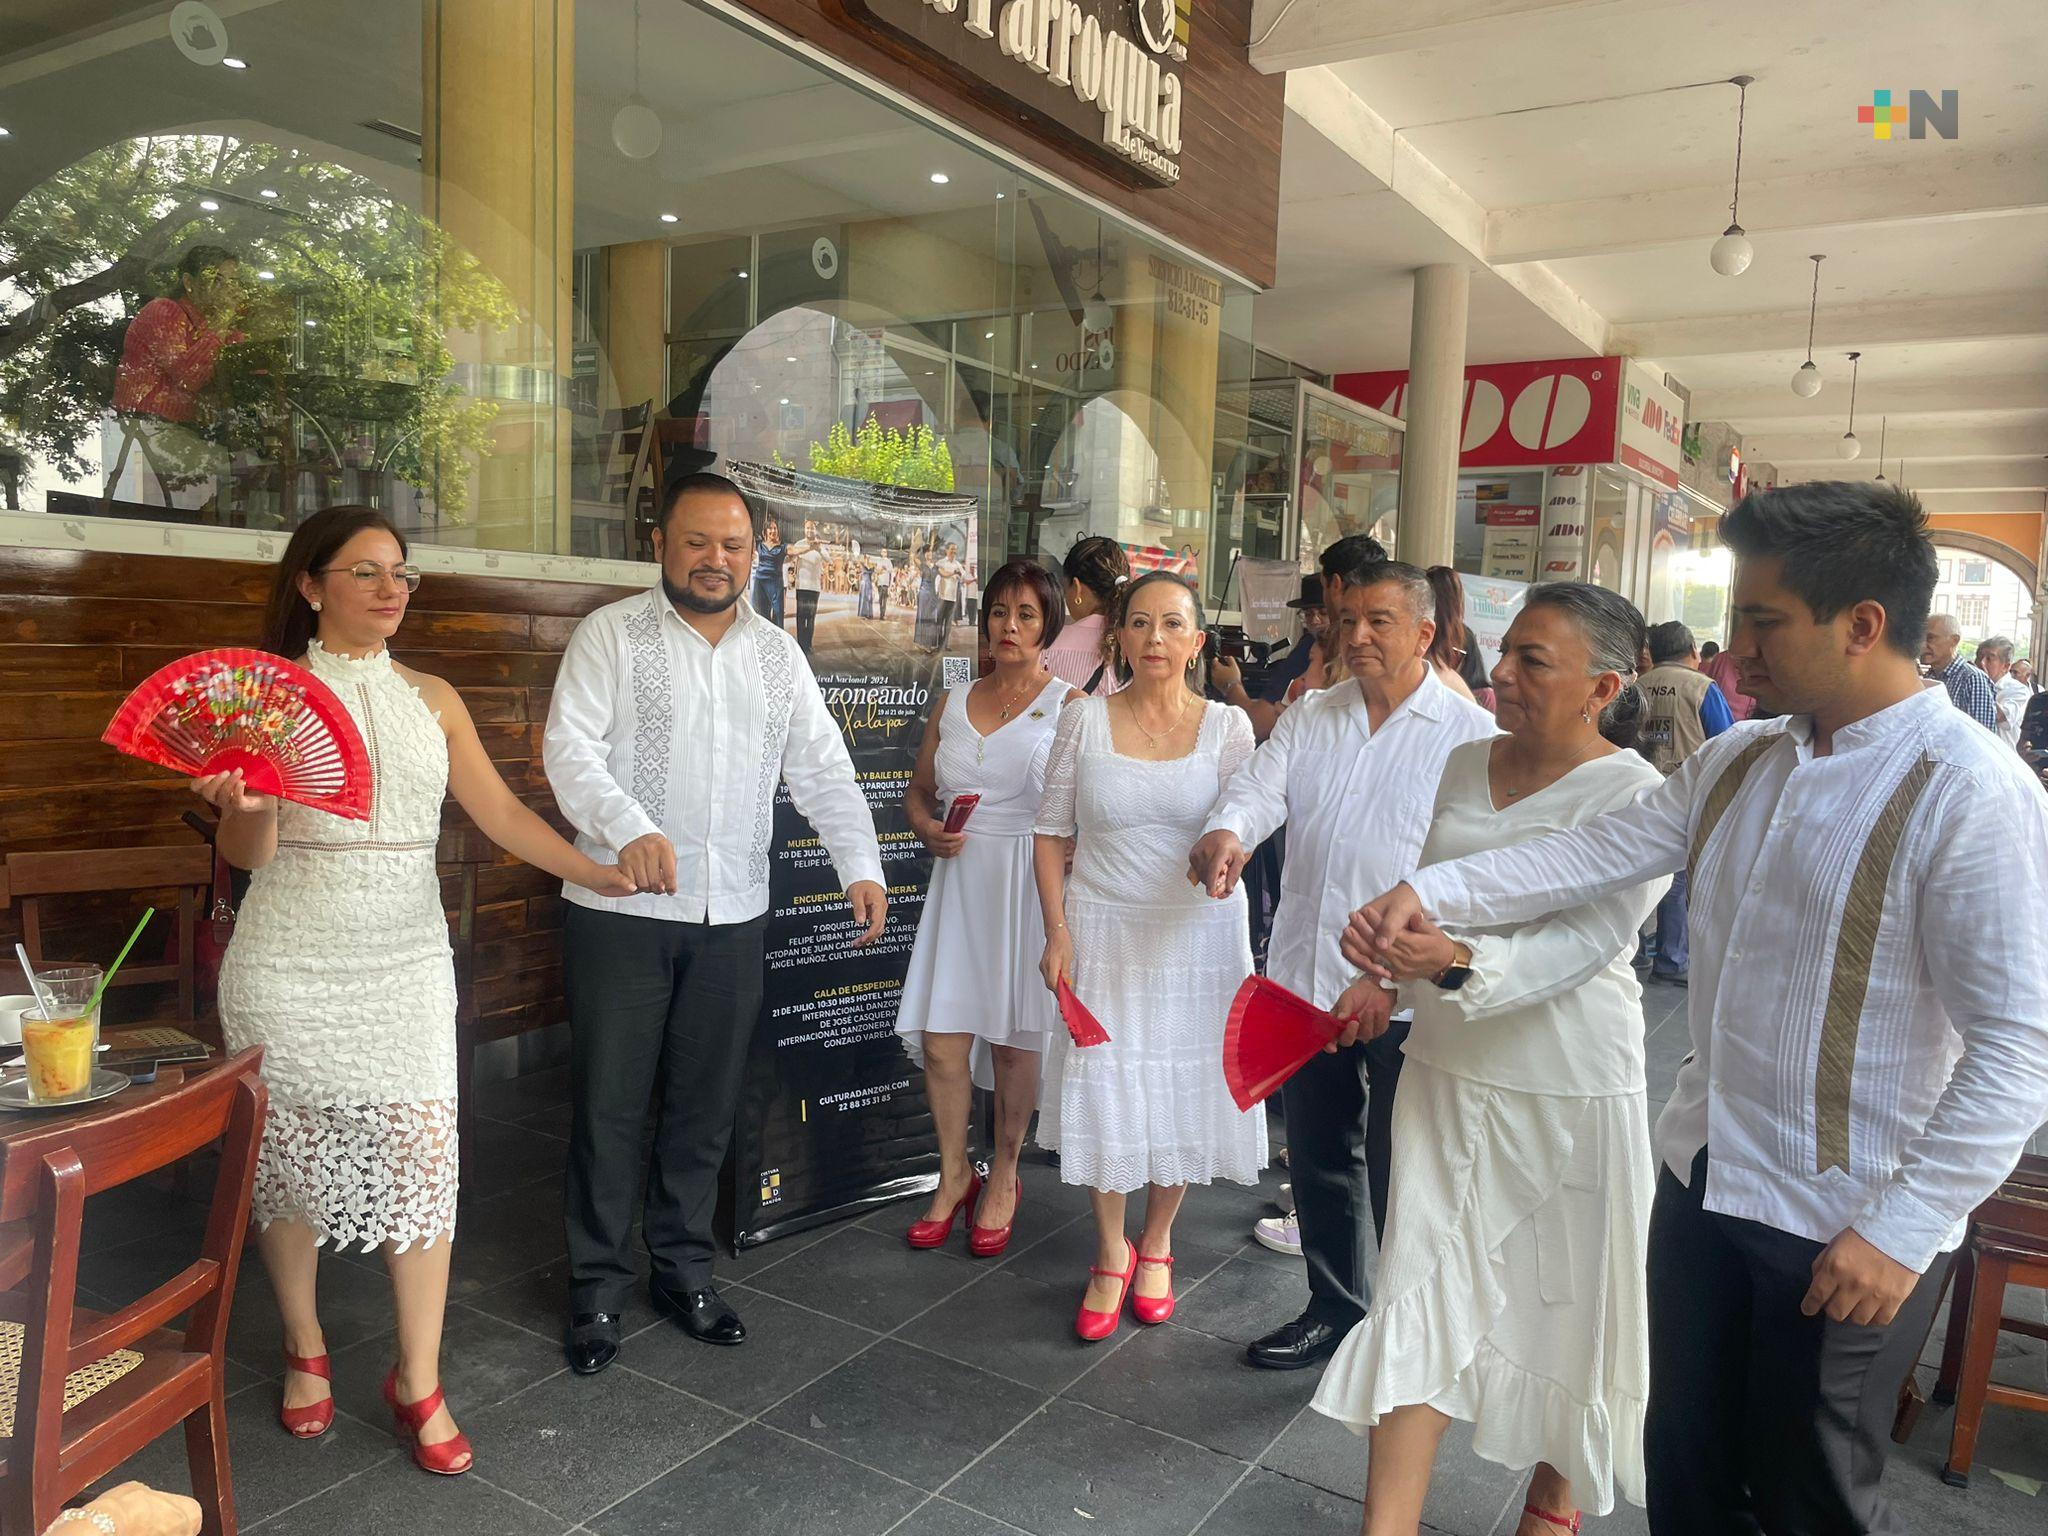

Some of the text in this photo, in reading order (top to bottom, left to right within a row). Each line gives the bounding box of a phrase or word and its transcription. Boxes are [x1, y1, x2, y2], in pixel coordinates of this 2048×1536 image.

[963, 0, 1181, 155] arroquia
[1123, 128, 1180, 181] de Veracruz
[1663, 410, 1680, 446] FedEx
[1548, 496, 1577, 506] ADO
[1548, 523, 1584, 537] ADO
[815, 674, 889, 685] ival Nacional 2024
[832, 690, 908, 747] Xalapa
[905, 708, 916, 718] julio
[1645, 720, 1670, 732] MVS
[862, 772, 868, 780] Y
[869, 771, 892, 780] BAILE
[892, 770, 903, 779] DE
[904, 770, 913, 778] BI
[866, 781, 895, 791] PARQUE
[896, 779, 910, 788] JUÁ
[775, 796, 793, 804] DAN
[864, 791, 897, 800] CULTURA
[868, 801, 884, 809] EVA
[884, 829, 917, 841] DANZÓ
[779, 851, 789, 859] 20
[790, 850, 802, 859] DE
[880, 842, 898, 852] QUE
[898, 840, 926, 850] JUÁRE
[794, 851, 916, 869] FELIPE UR ZONERA
[793, 885, 917, 904] ENCUENTRO NERAS
[775, 909, 785, 917] 20
[785, 908, 797, 916] DE
[898, 894, 926, 903] CARAC
[788, 936, 814, 946] FELIPE
[891, 924, 918, 932] VAREL
[813, 925, 818, 933] 7
[765, 948, 799, 960] ACTOPAN
[801, 946, 812, 955] DE
[814, 944, 834, 953] JUAN
[770, 960, 795, 970] ÁNGEL
[828, 949, 864, 960] CULTURA
[865, 944, 899, 956] DANZÓN
[814, 979, 900, 999] GALA DE DESPEDIDA
[772, 1009, 780, 1018] 21
[781, 1006, 791, 1016] DE
[817, 998, 838, 1008] 10:30
[838, 996, 855, 1006] HRS
[856, 992, 882, 1002] HOTEL
[802, 999, 900, 1021] INTERNACIONAL DANZON
[820, 1010, 897, 1029] DE JOSÉ CASQUERA
[778, 1028, 839, 1048] INTERNACIONAL
[840, 1020, 890, 1036] DANZONERA
[823, 1029, 894, 1048] GONZALO VARELA
[819, 1079, 910, 1106] CULTURADANZON.COM
[838, 1093, 891, 1111] 22 88 35 31 85
[772, 1188, 779, 1196] D
